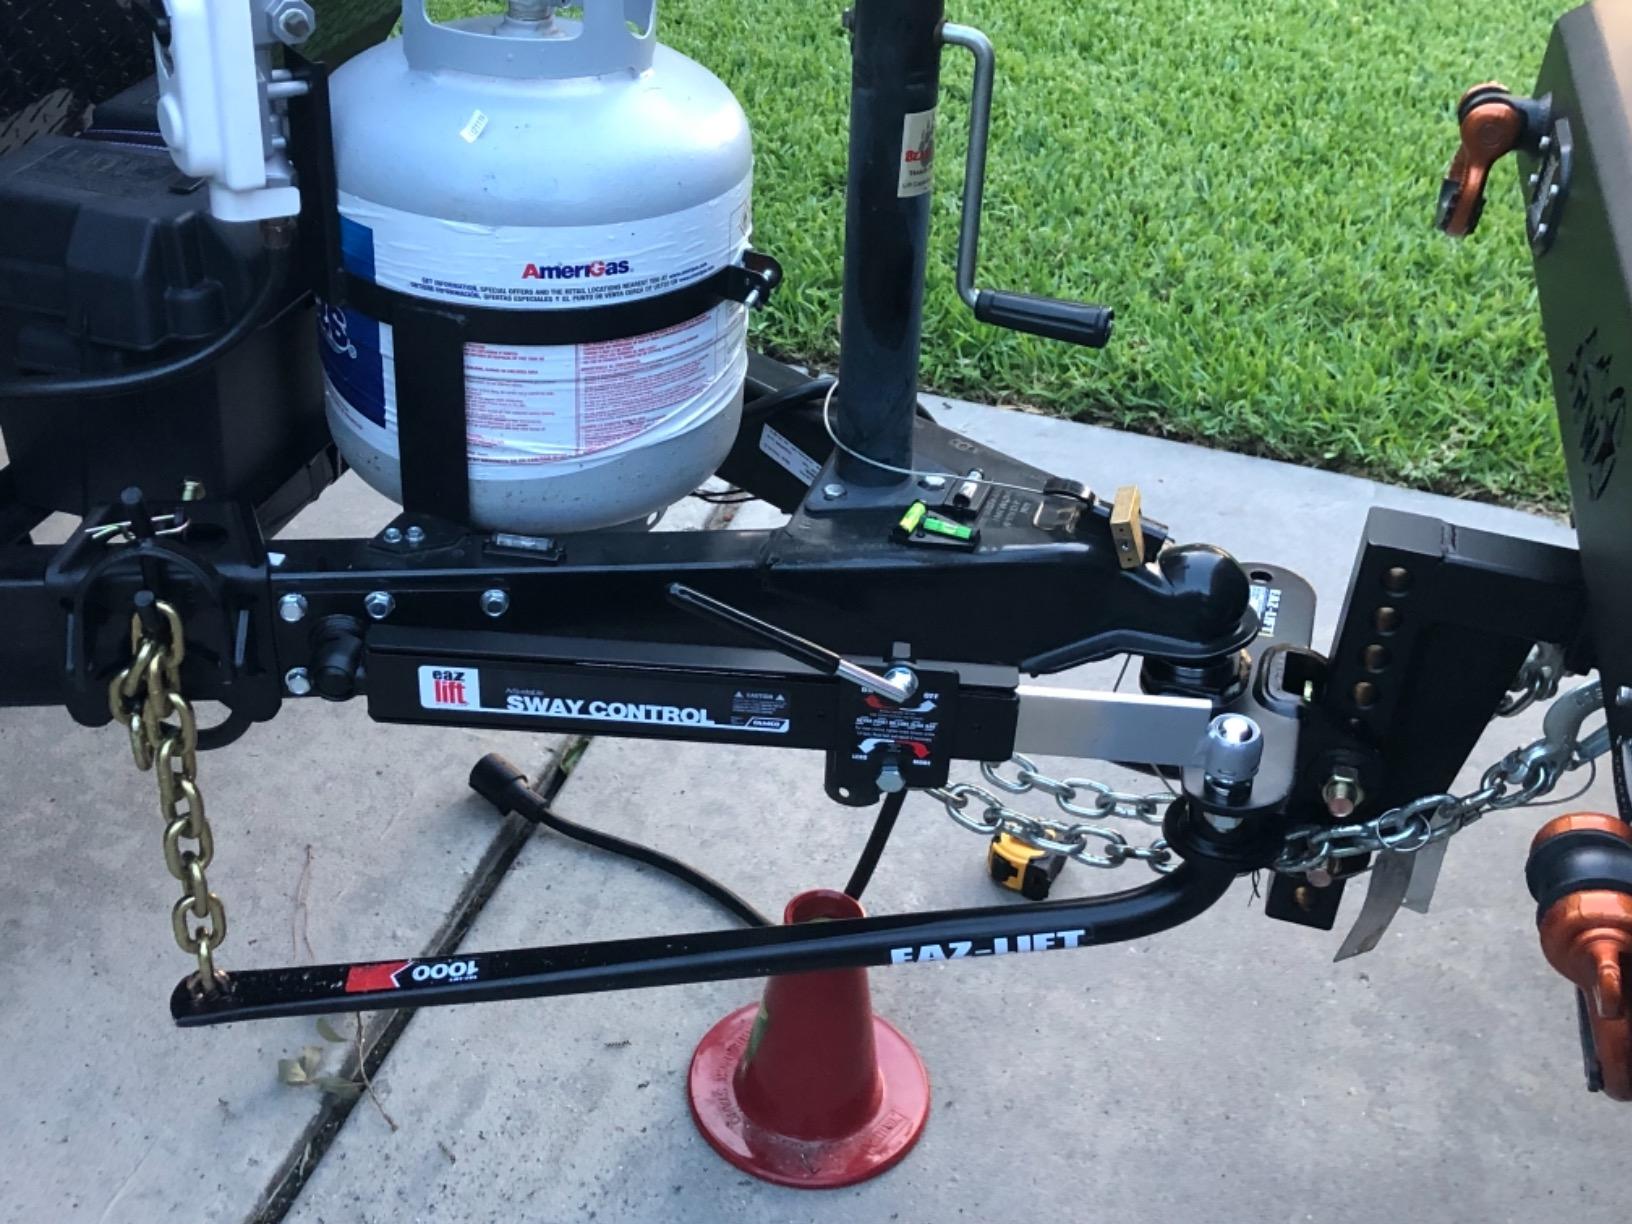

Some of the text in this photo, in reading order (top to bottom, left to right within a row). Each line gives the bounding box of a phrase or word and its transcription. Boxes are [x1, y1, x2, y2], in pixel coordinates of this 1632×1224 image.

[522, 260, 629, 279] AmeriGas
[432, 670, 465, 681] eaz
[434, 679, 467, 705] lift
[507, 695, 584, 715] SWAY
[588, 700, 715, 726] CONTROL
[412, 960, 479, 981] 1000
